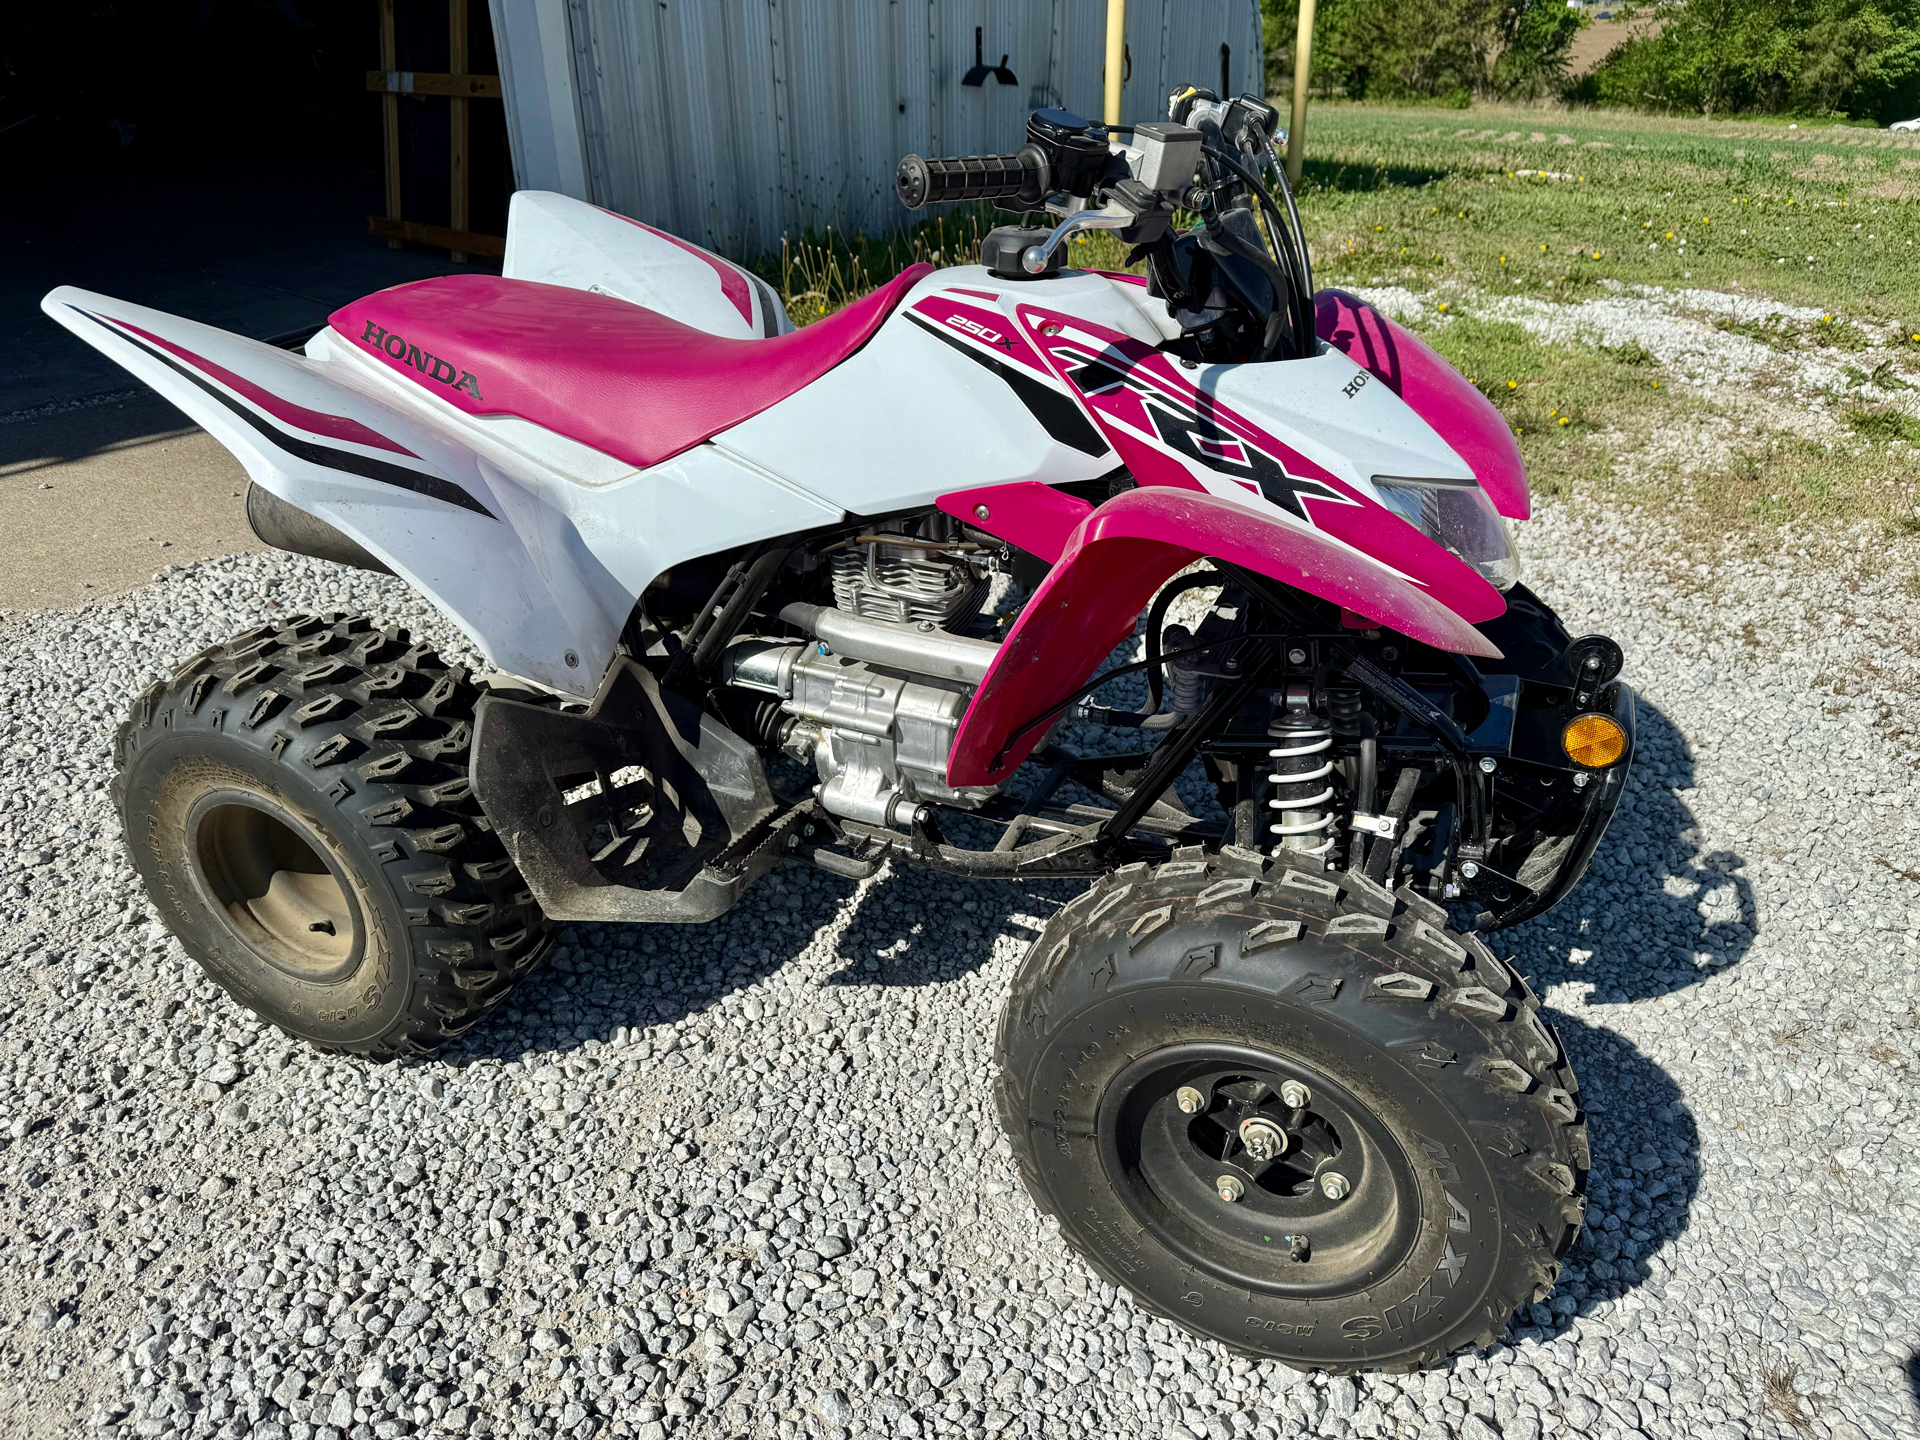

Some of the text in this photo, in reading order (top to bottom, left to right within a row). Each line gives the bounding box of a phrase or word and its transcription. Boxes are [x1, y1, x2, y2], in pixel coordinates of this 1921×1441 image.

[360, 320, 483, 401] HONDA
[945, 314, 1020, 351] 250X
[1341, 1130, 1472, 1341] MAXXIS
